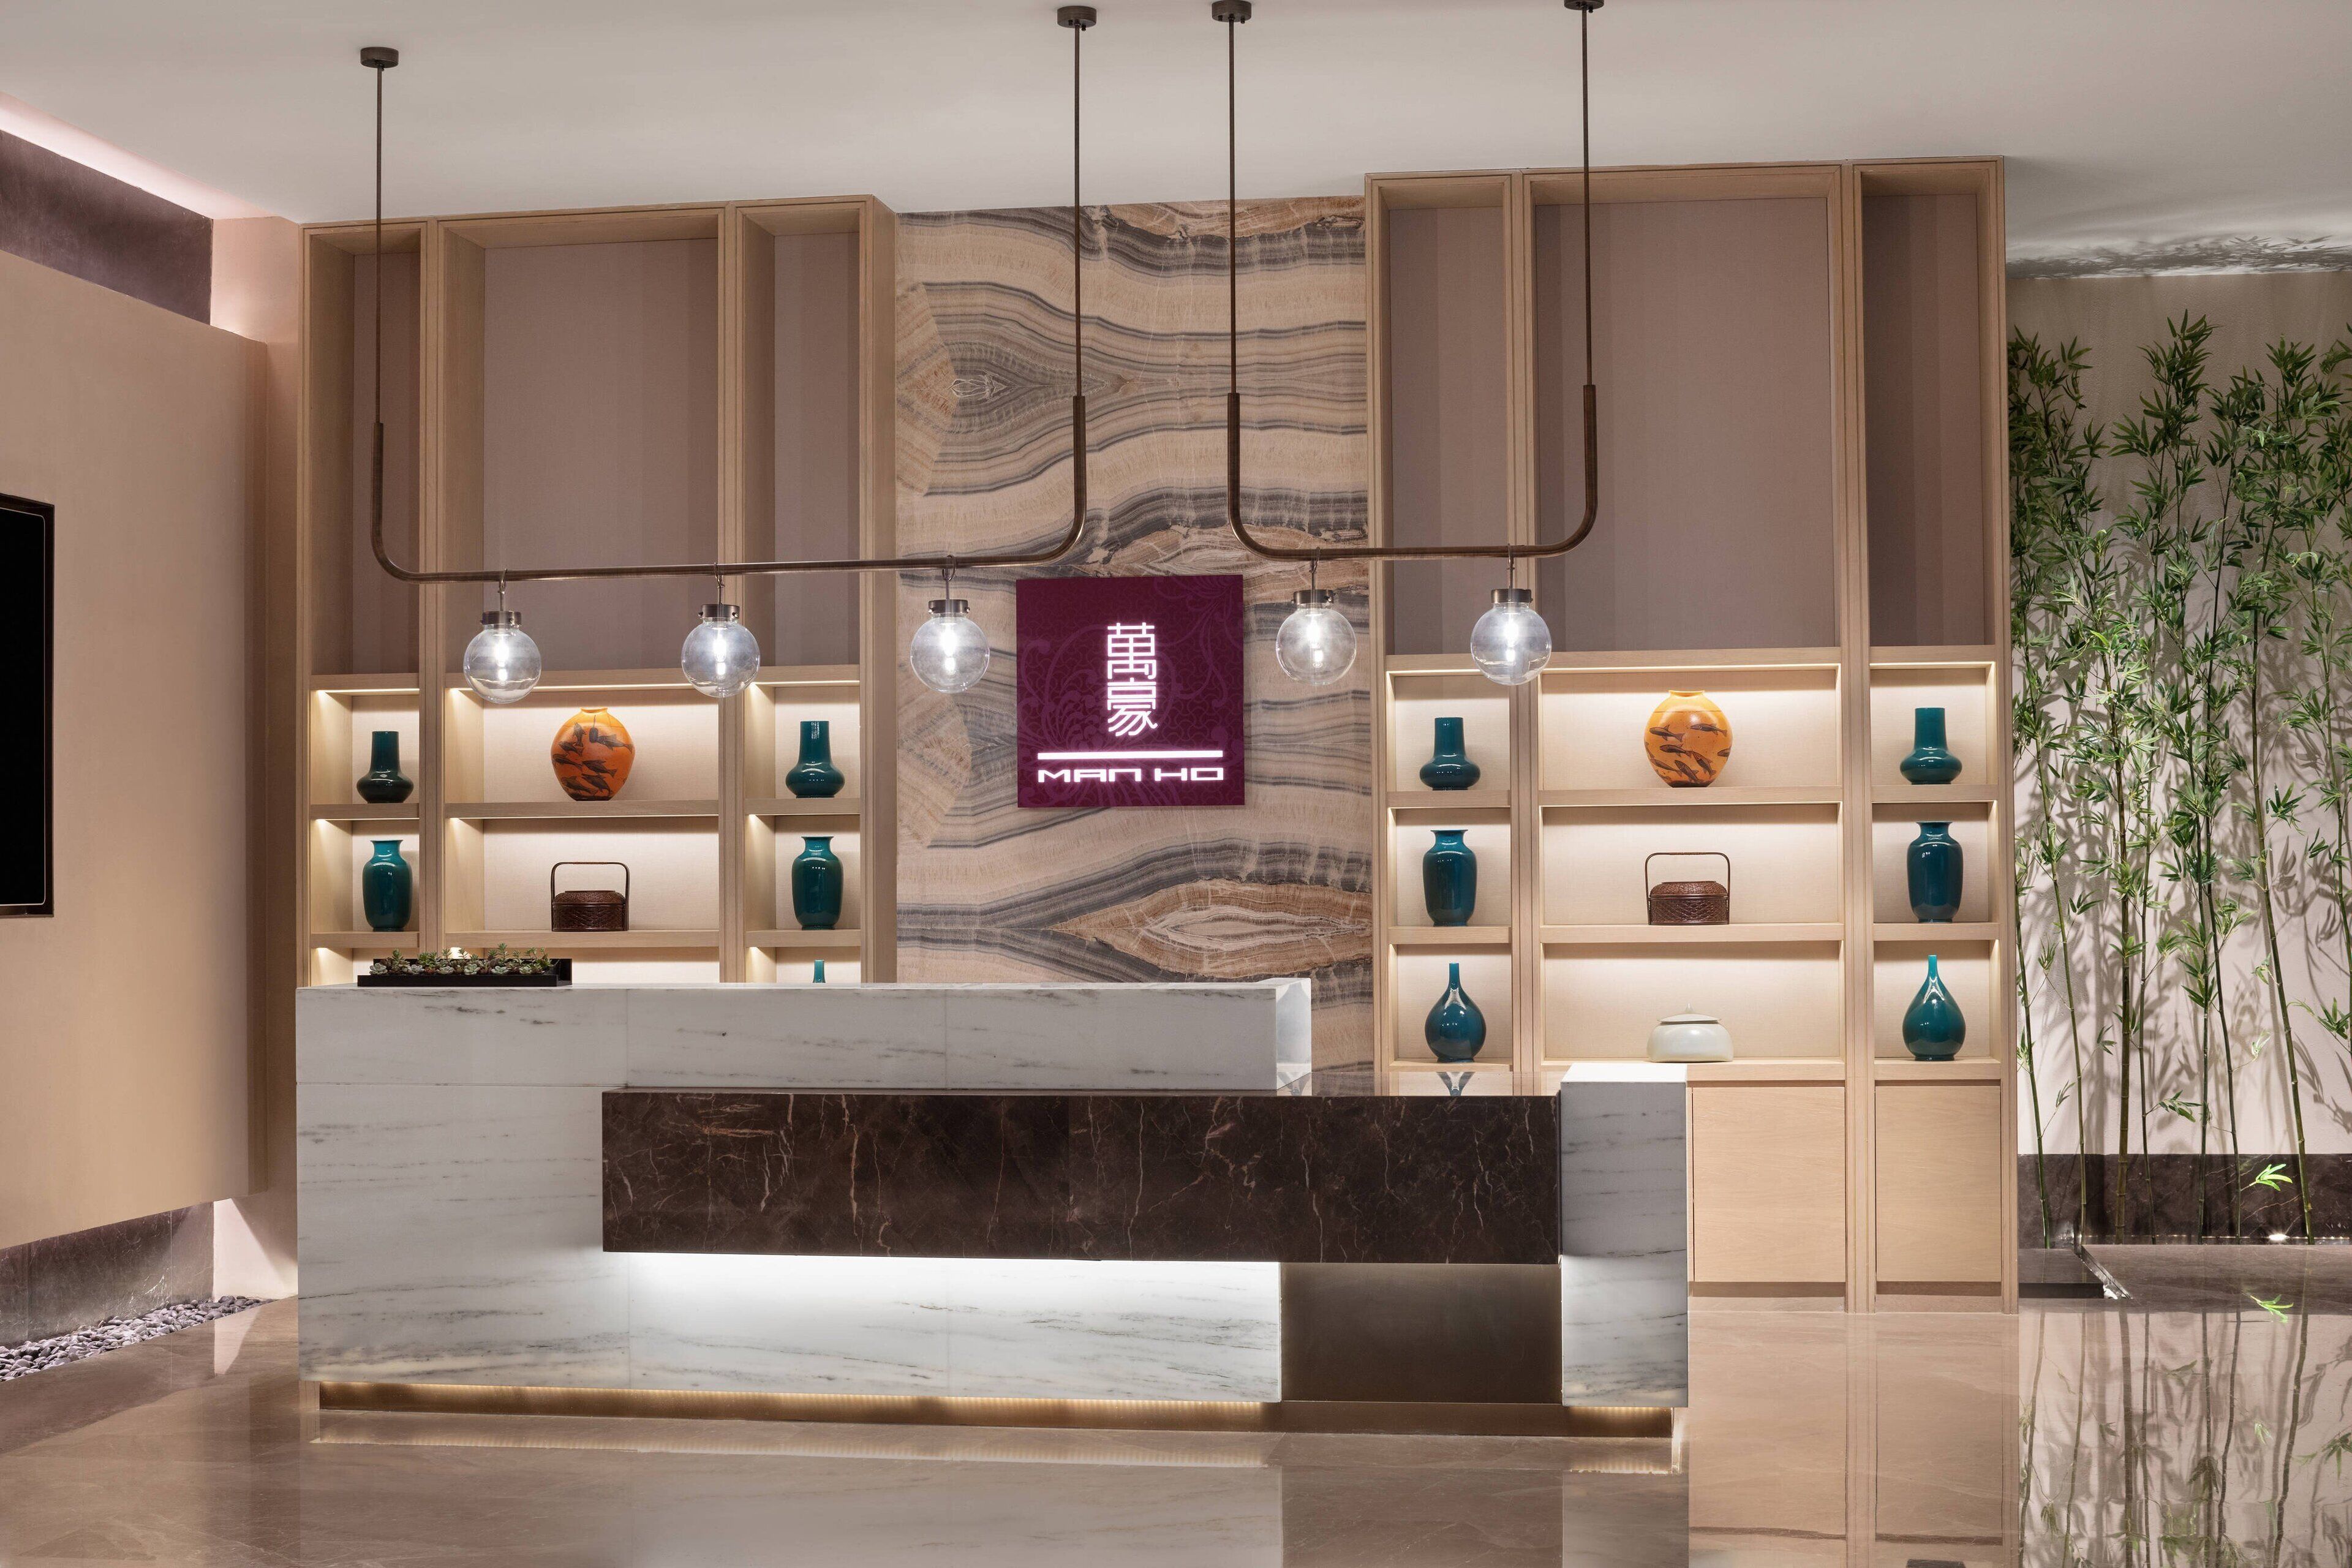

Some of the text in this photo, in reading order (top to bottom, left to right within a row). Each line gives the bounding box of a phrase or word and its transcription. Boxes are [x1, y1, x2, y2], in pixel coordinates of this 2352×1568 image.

[1107, 622, 1158, 737] 萬豪
[1038, 767, 1224, 783] MAN HO
